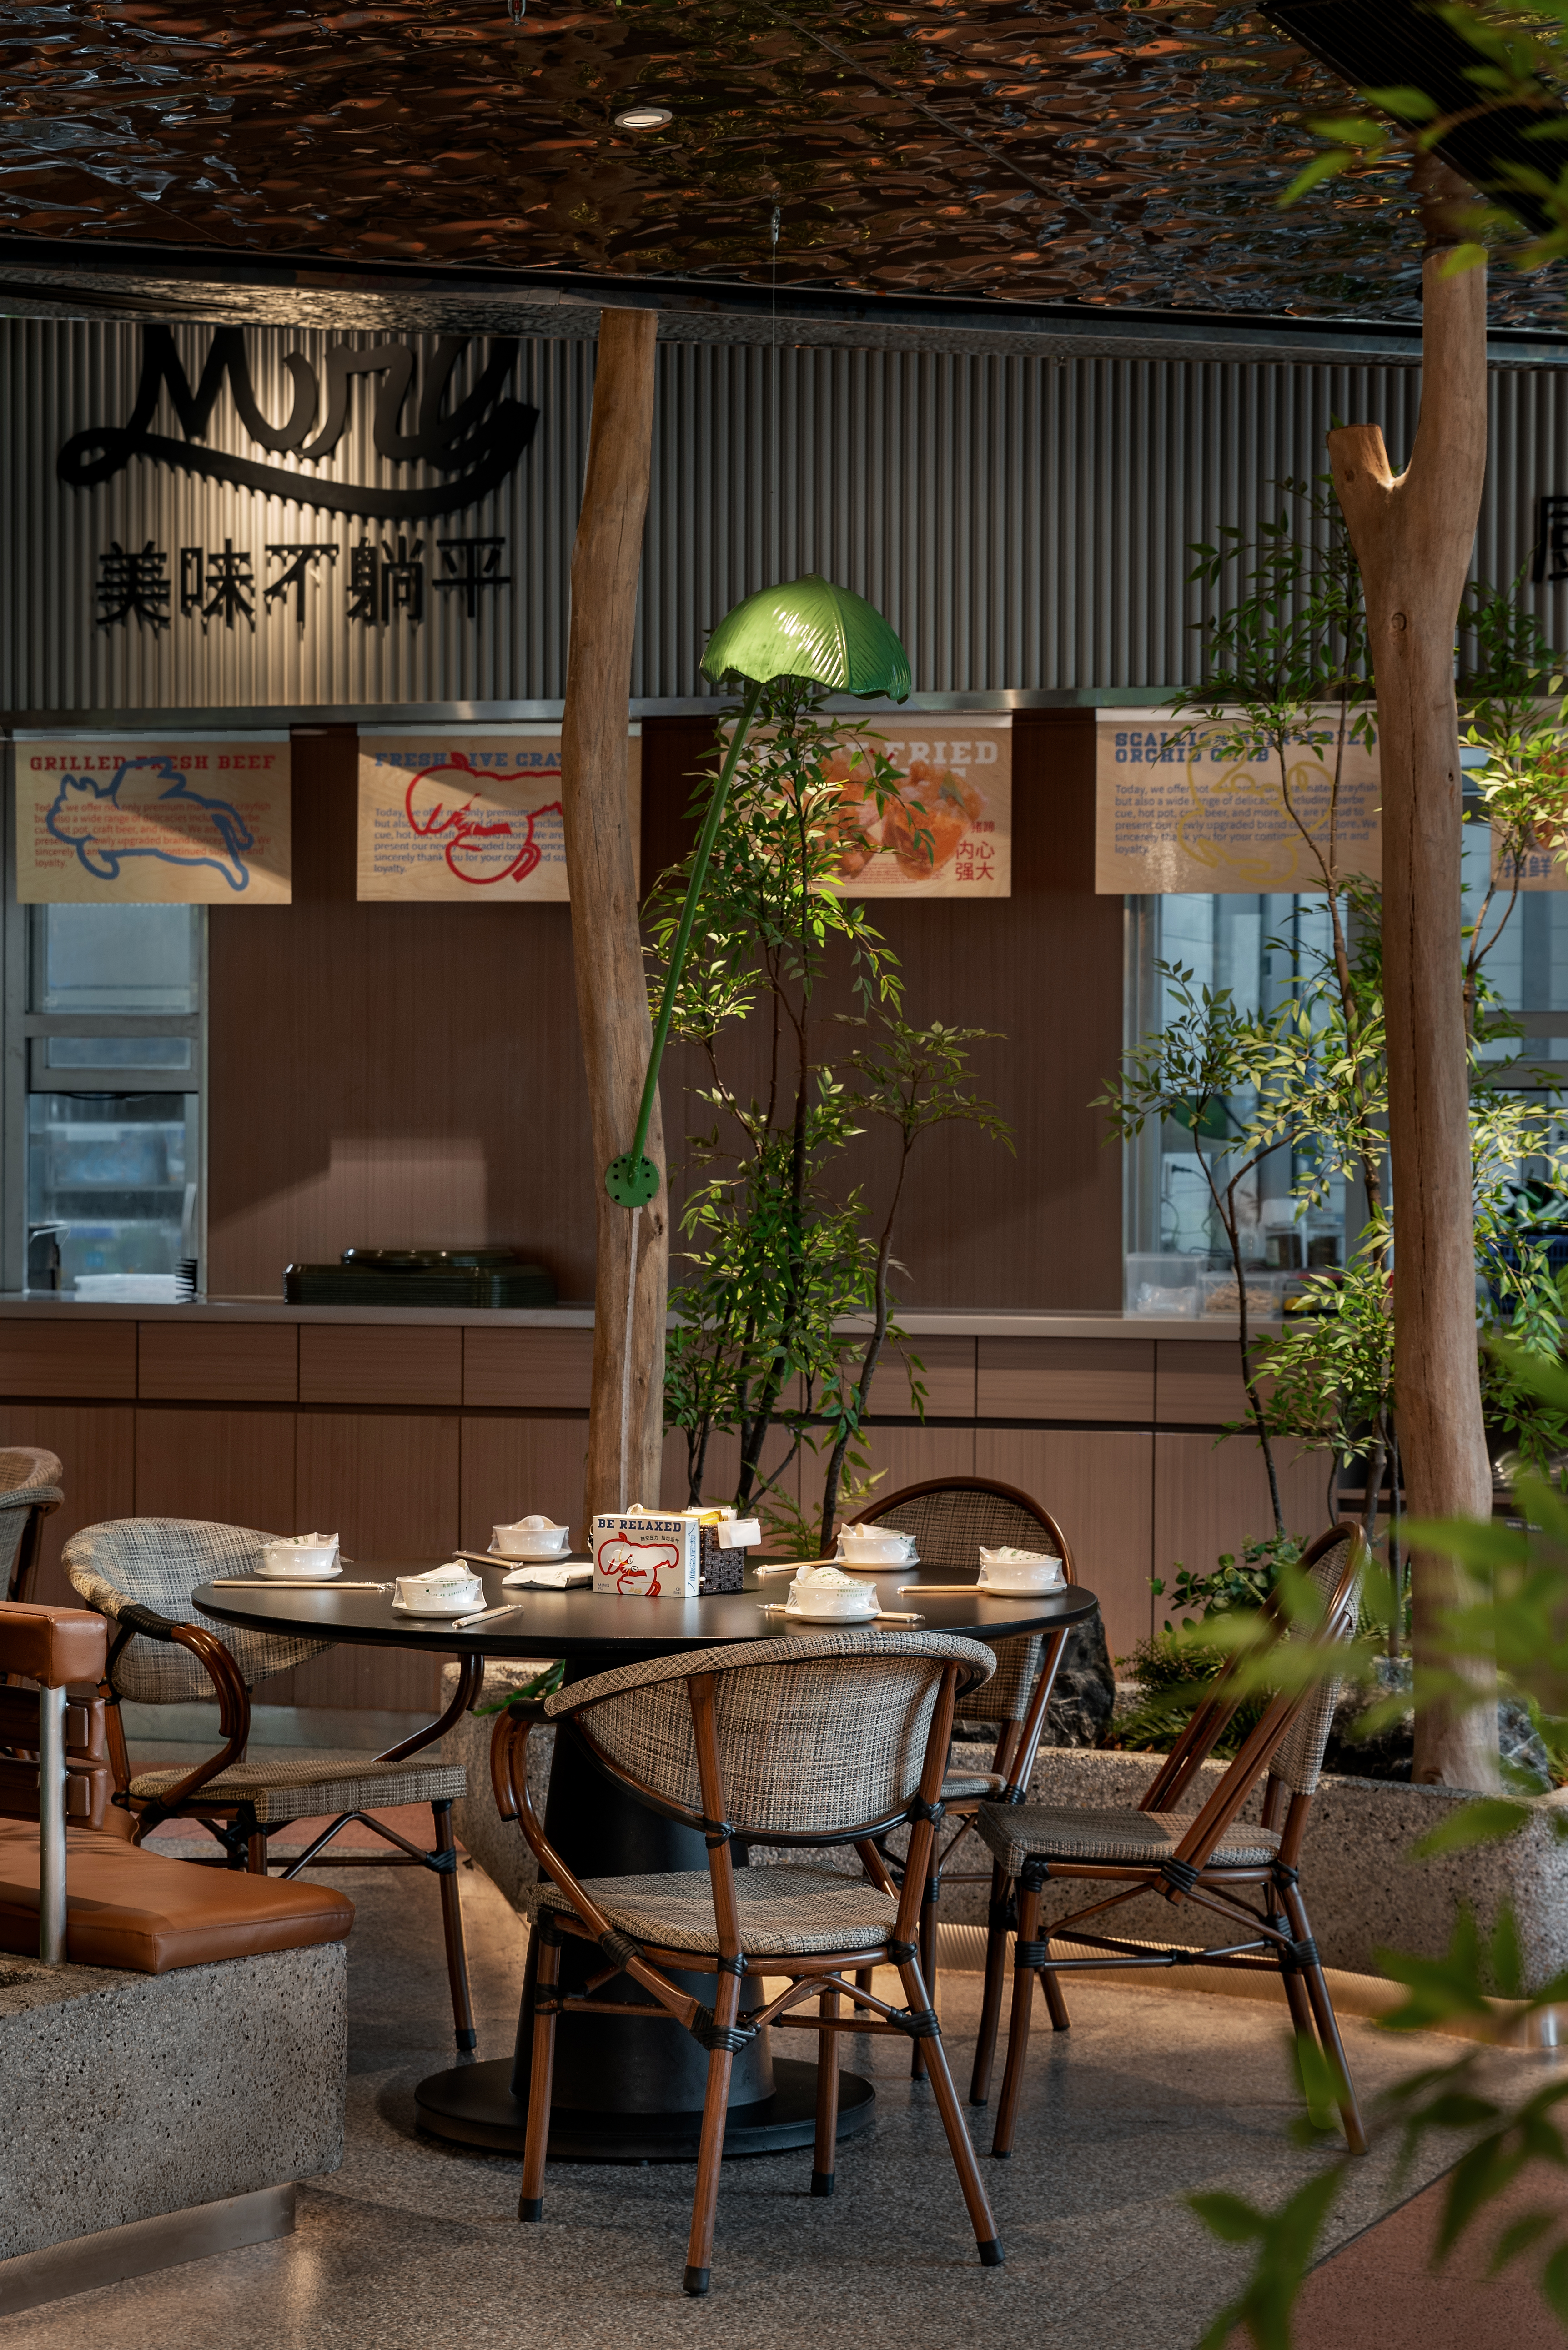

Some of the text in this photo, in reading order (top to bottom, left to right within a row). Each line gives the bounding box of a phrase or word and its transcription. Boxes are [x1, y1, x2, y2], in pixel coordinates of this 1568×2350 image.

[96, 537, 511, 625] 美味不躺平
[884, 742, 999, 765] FRIED
[30, 755, 126, 771] GRILLED
[218, 755, 276, 770] BEEF
[375, 753, 447, 767] FRESH
[457, 753, 508, 767] IVE
[1116, 784, 1148, 796] Today,
[1167, 783, 1190, 794] offer
[1115, 797, 1132, 806] but
[1135, 797, 1155, 806] also
[1166, 797, 1190, 805] wide
[1222, 796, 1232, 805] of
[81, 802, 101, 812] offer
[121, 803, 141, 814] only
[144, 803, 185, 813] premium
[235, 802, 271, 813] crayfish
[376, 808, 405, 818] Today,
[487, 810, 529, 818] premium
[1115, 810, 1136, 819] cue,
[1138, 808, 1155, 818] hot
[1232, 808, 1251, 817] and
[1353, 808, 1365, 817] to
[80, 814, 101, 823] wide
[104, 815, 130, 825] range
[143, 813, 187, 823] delicacies
[375, 819, 390, 828] but
[93, 824, 113, 834] craft
[141, 825, 157, 834] and
[1115, 821, 1153, 832] present
[1206, 820, 1255, 832] upgraded
[1257, 819, 1287, 829] brand
[1362, 819, 1377, 828] We
[375, 832, 394, 840] cue,
[396, 831, 411, 839] hot
[1115, 833, 1159, 844] sincerely
[1213, 832, 1227, 841] for
[1229, 834, 1252, 844] your
[1350, 831, 1370, 840] and
[118, 836, 161, 849] upgraded
[164, 836, 190, 844] brand
[374, 843, 409, 852] present
[35, 847, 75, 858] sincerely
[956, 840, 995, 860] 内心
[374, 853, 415, 864] sincerely
[417, 853, 444, 861] thank
[481, 855, 502, 864] your
[374, 864, 407, 874] loyalty.
[955, 861, 994, 881] 强大
[598, 1518, 681, 1532] BE RELAXED
[661, 1535, 680, 1544] 抽出运气
